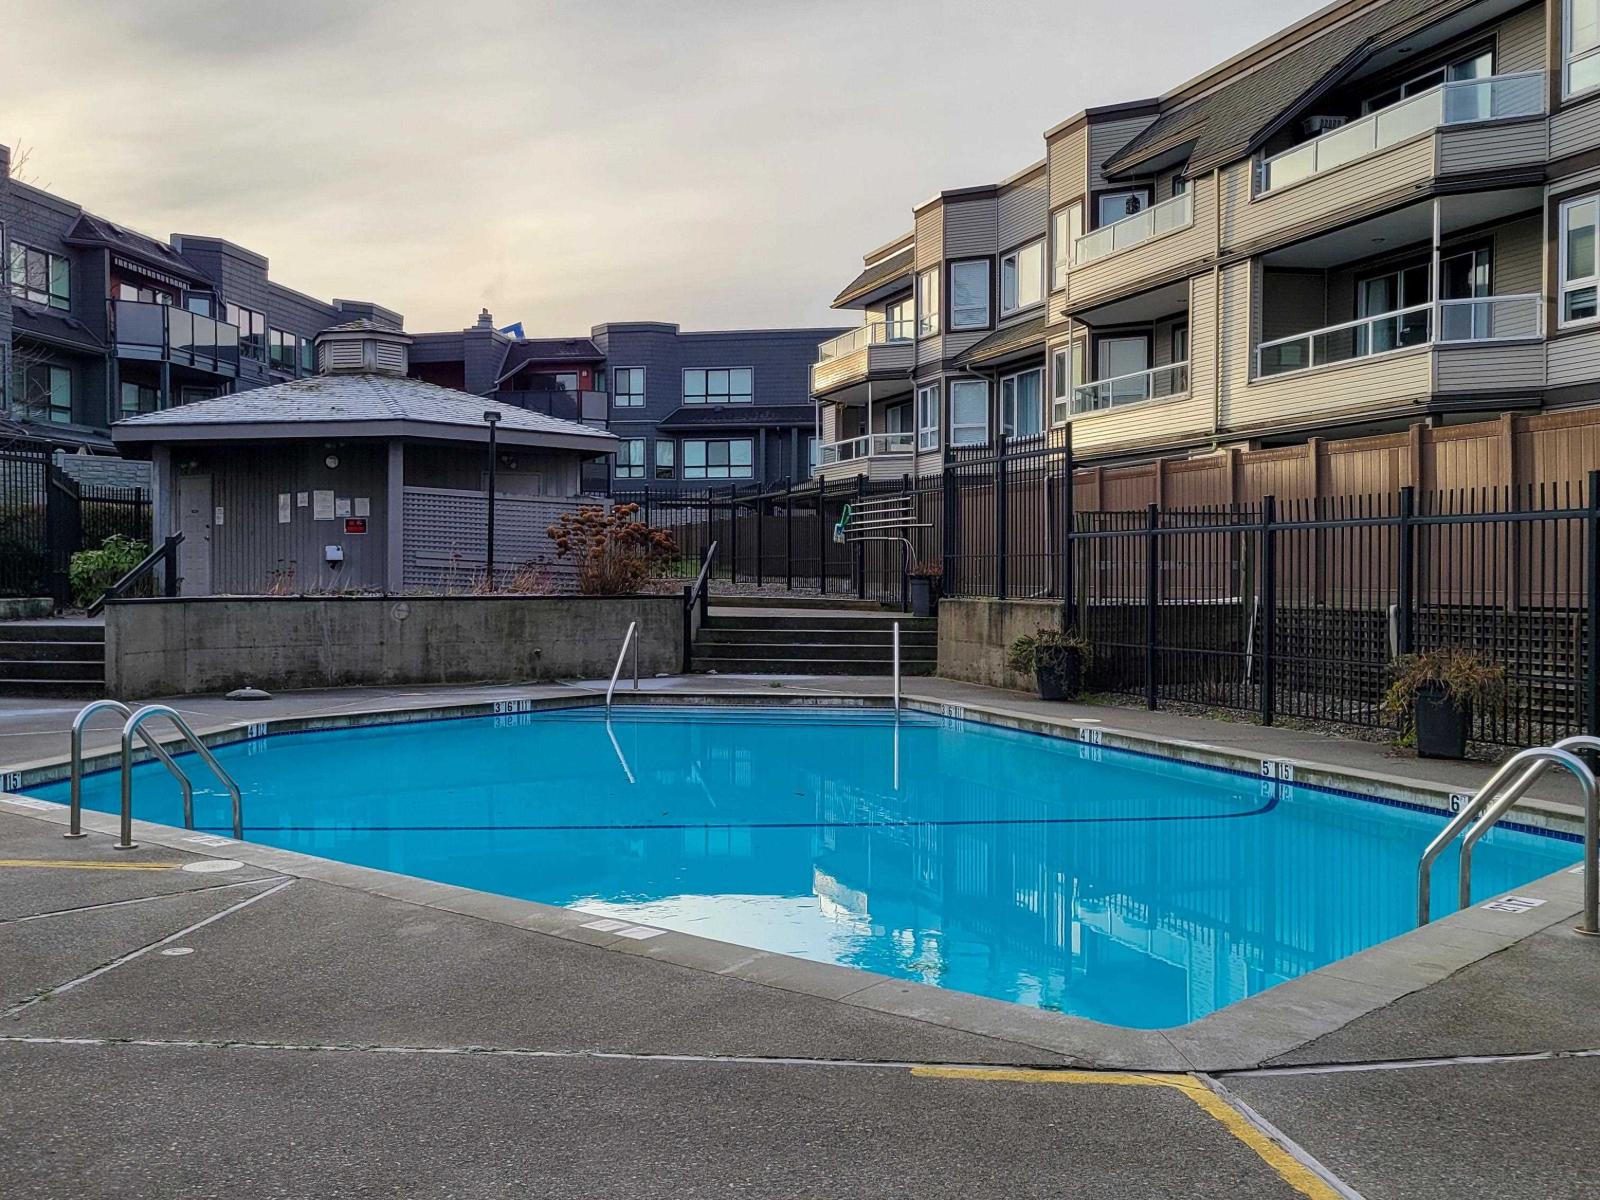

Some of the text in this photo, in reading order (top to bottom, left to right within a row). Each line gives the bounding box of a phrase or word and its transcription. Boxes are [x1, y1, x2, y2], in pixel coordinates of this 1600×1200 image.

[494, 702, 501, 713] 3
[507, 701, 513, 712] 6
[1262, 760, 1270, 776] 5
[1451, 794, 1460, 812] 6
